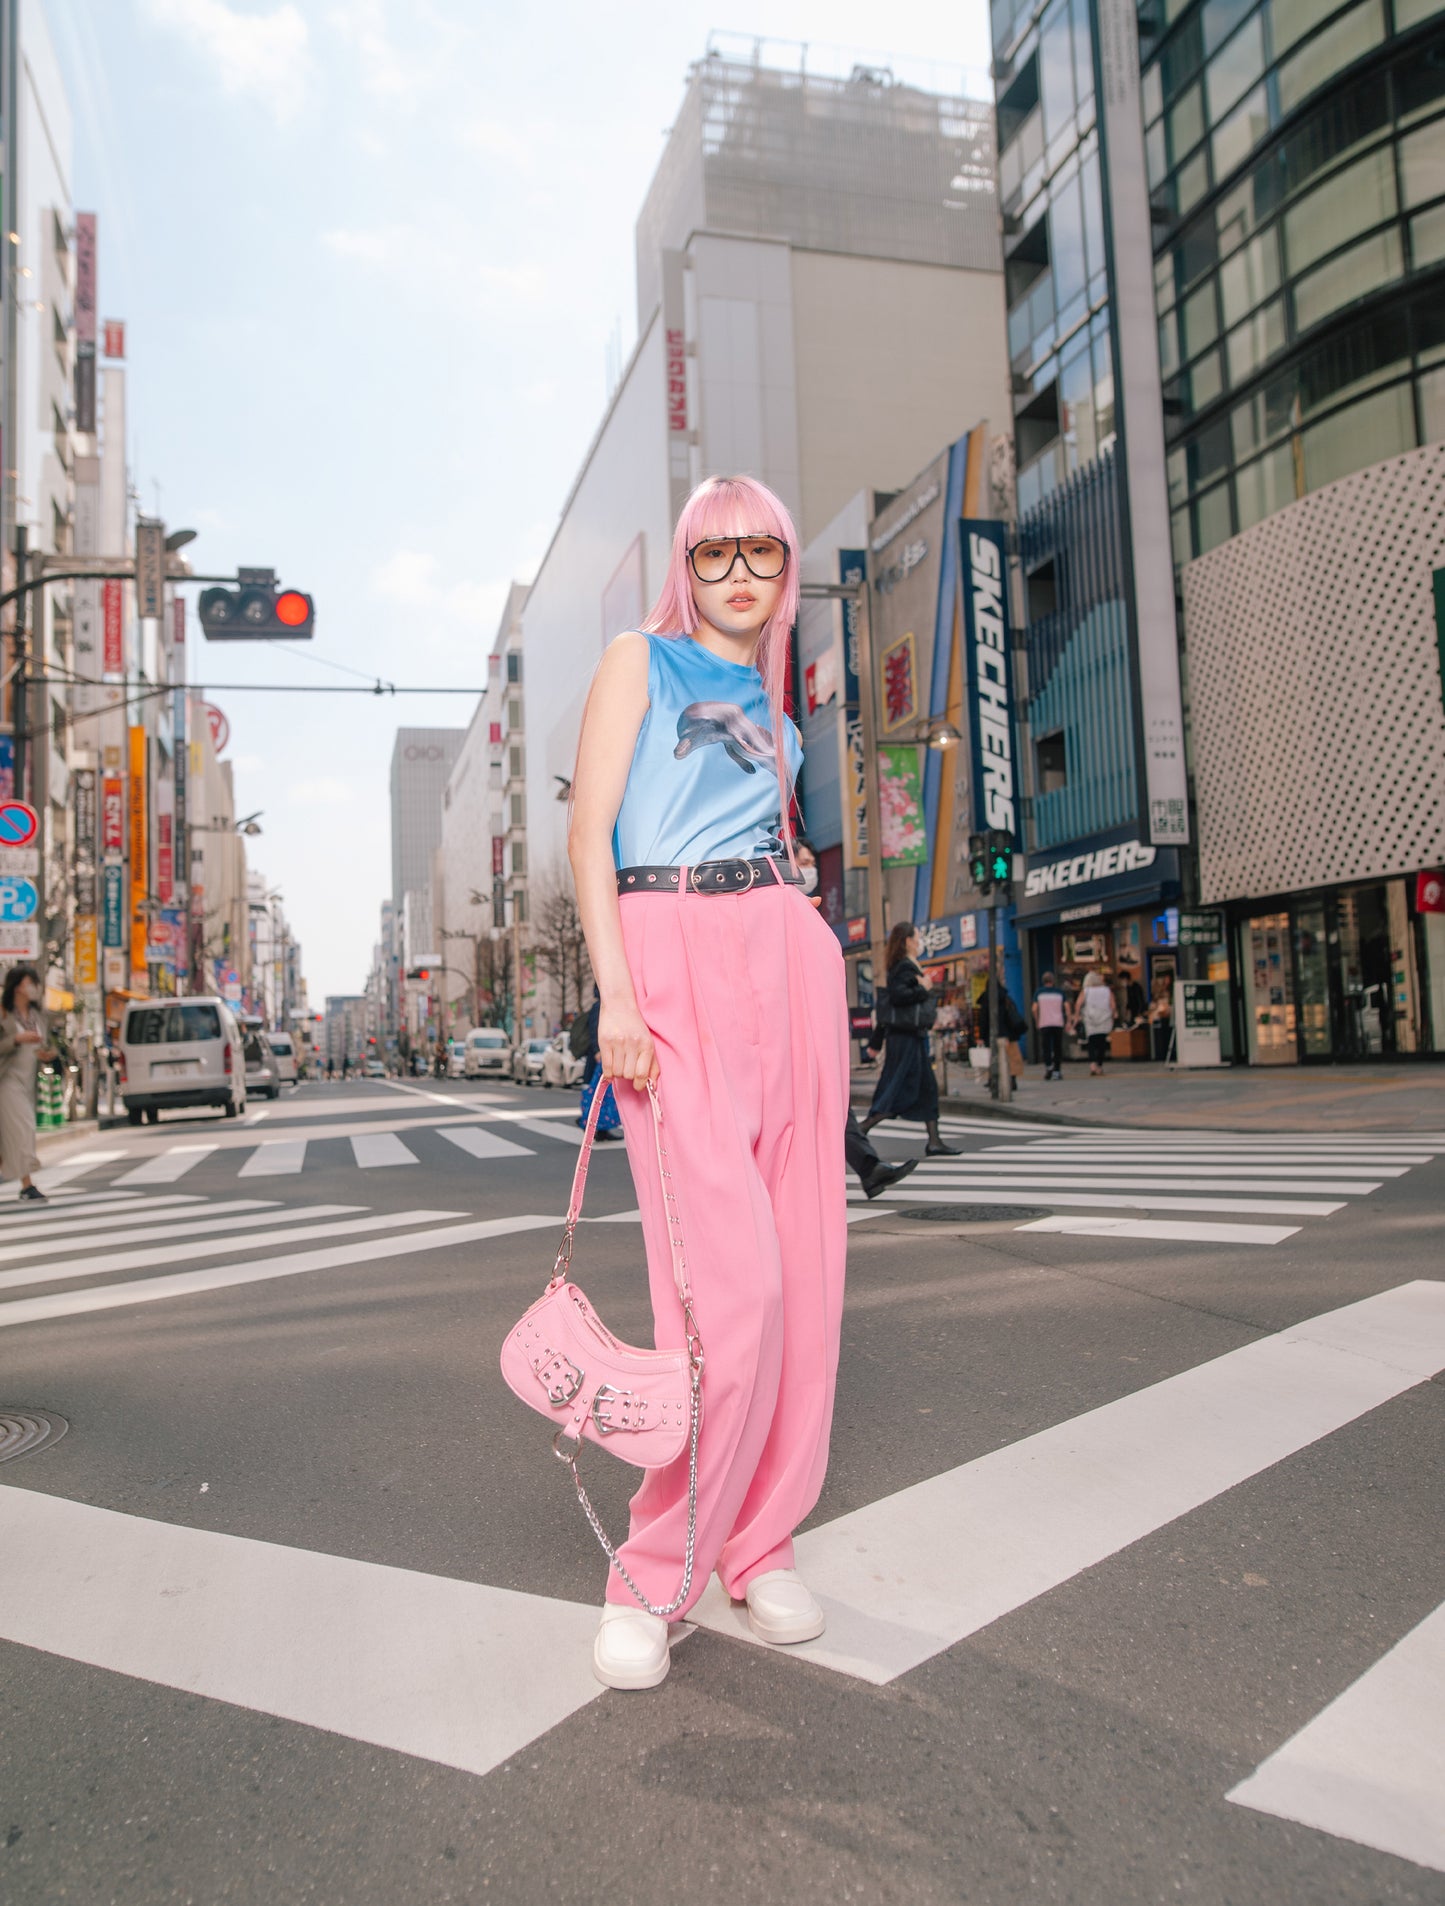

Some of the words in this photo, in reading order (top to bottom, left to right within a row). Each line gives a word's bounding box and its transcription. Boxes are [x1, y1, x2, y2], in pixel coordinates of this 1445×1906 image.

[970, 532, 1013, 834] SKECHERS
[1025, 840, 1156, 898] SKECHERS
[1060, 904, 1102, 922] SKECHERS
